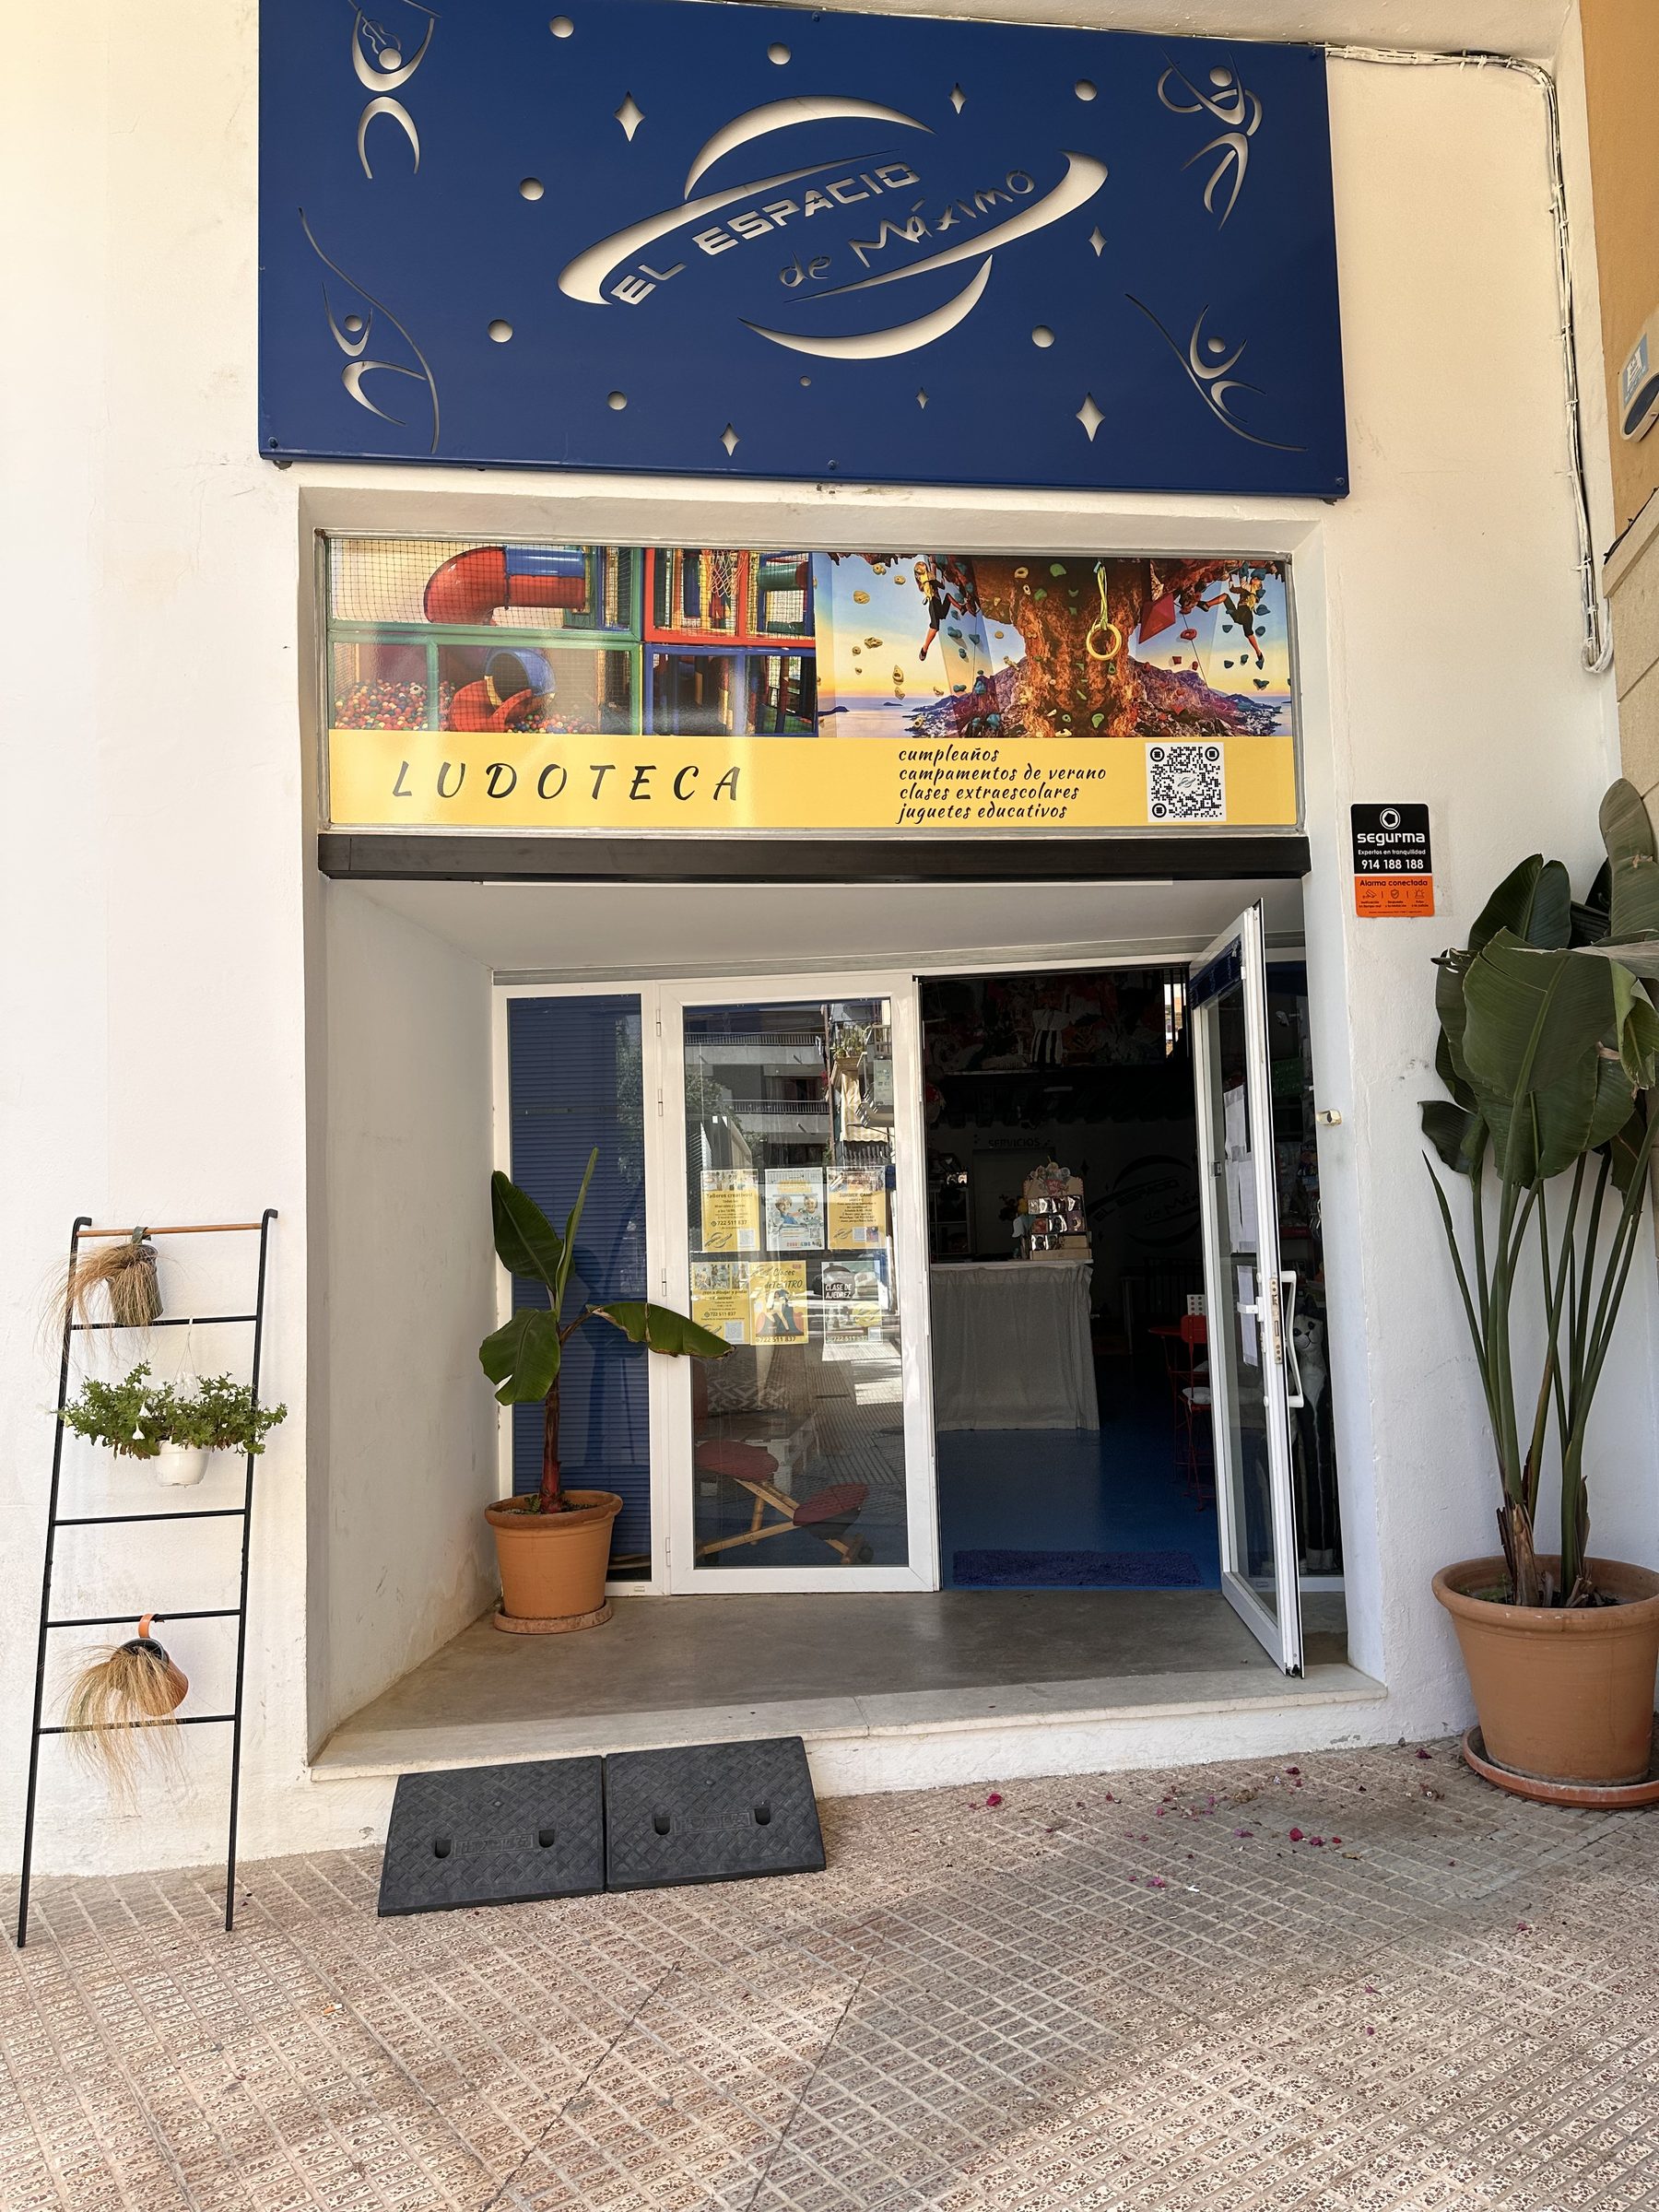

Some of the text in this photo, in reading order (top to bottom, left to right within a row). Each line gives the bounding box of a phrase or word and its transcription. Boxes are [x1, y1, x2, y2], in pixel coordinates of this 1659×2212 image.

[610, 161, 921, 306] EL ESPACIO
[779, 251, 832, 288] de
[899, 744, 1000, 767] cumpleaños
[392, 759, 741, 801] LUDOTECA
[899, 763, 1107, 786] campamentos de verano
[900, 782, 1080, 801] clases extraescolares
[895, 801, 1068, 825] juguetes educativos
[1357, 833, 1426, 846] segurma
[1361, 859, 1424, 869] 914 188 188
